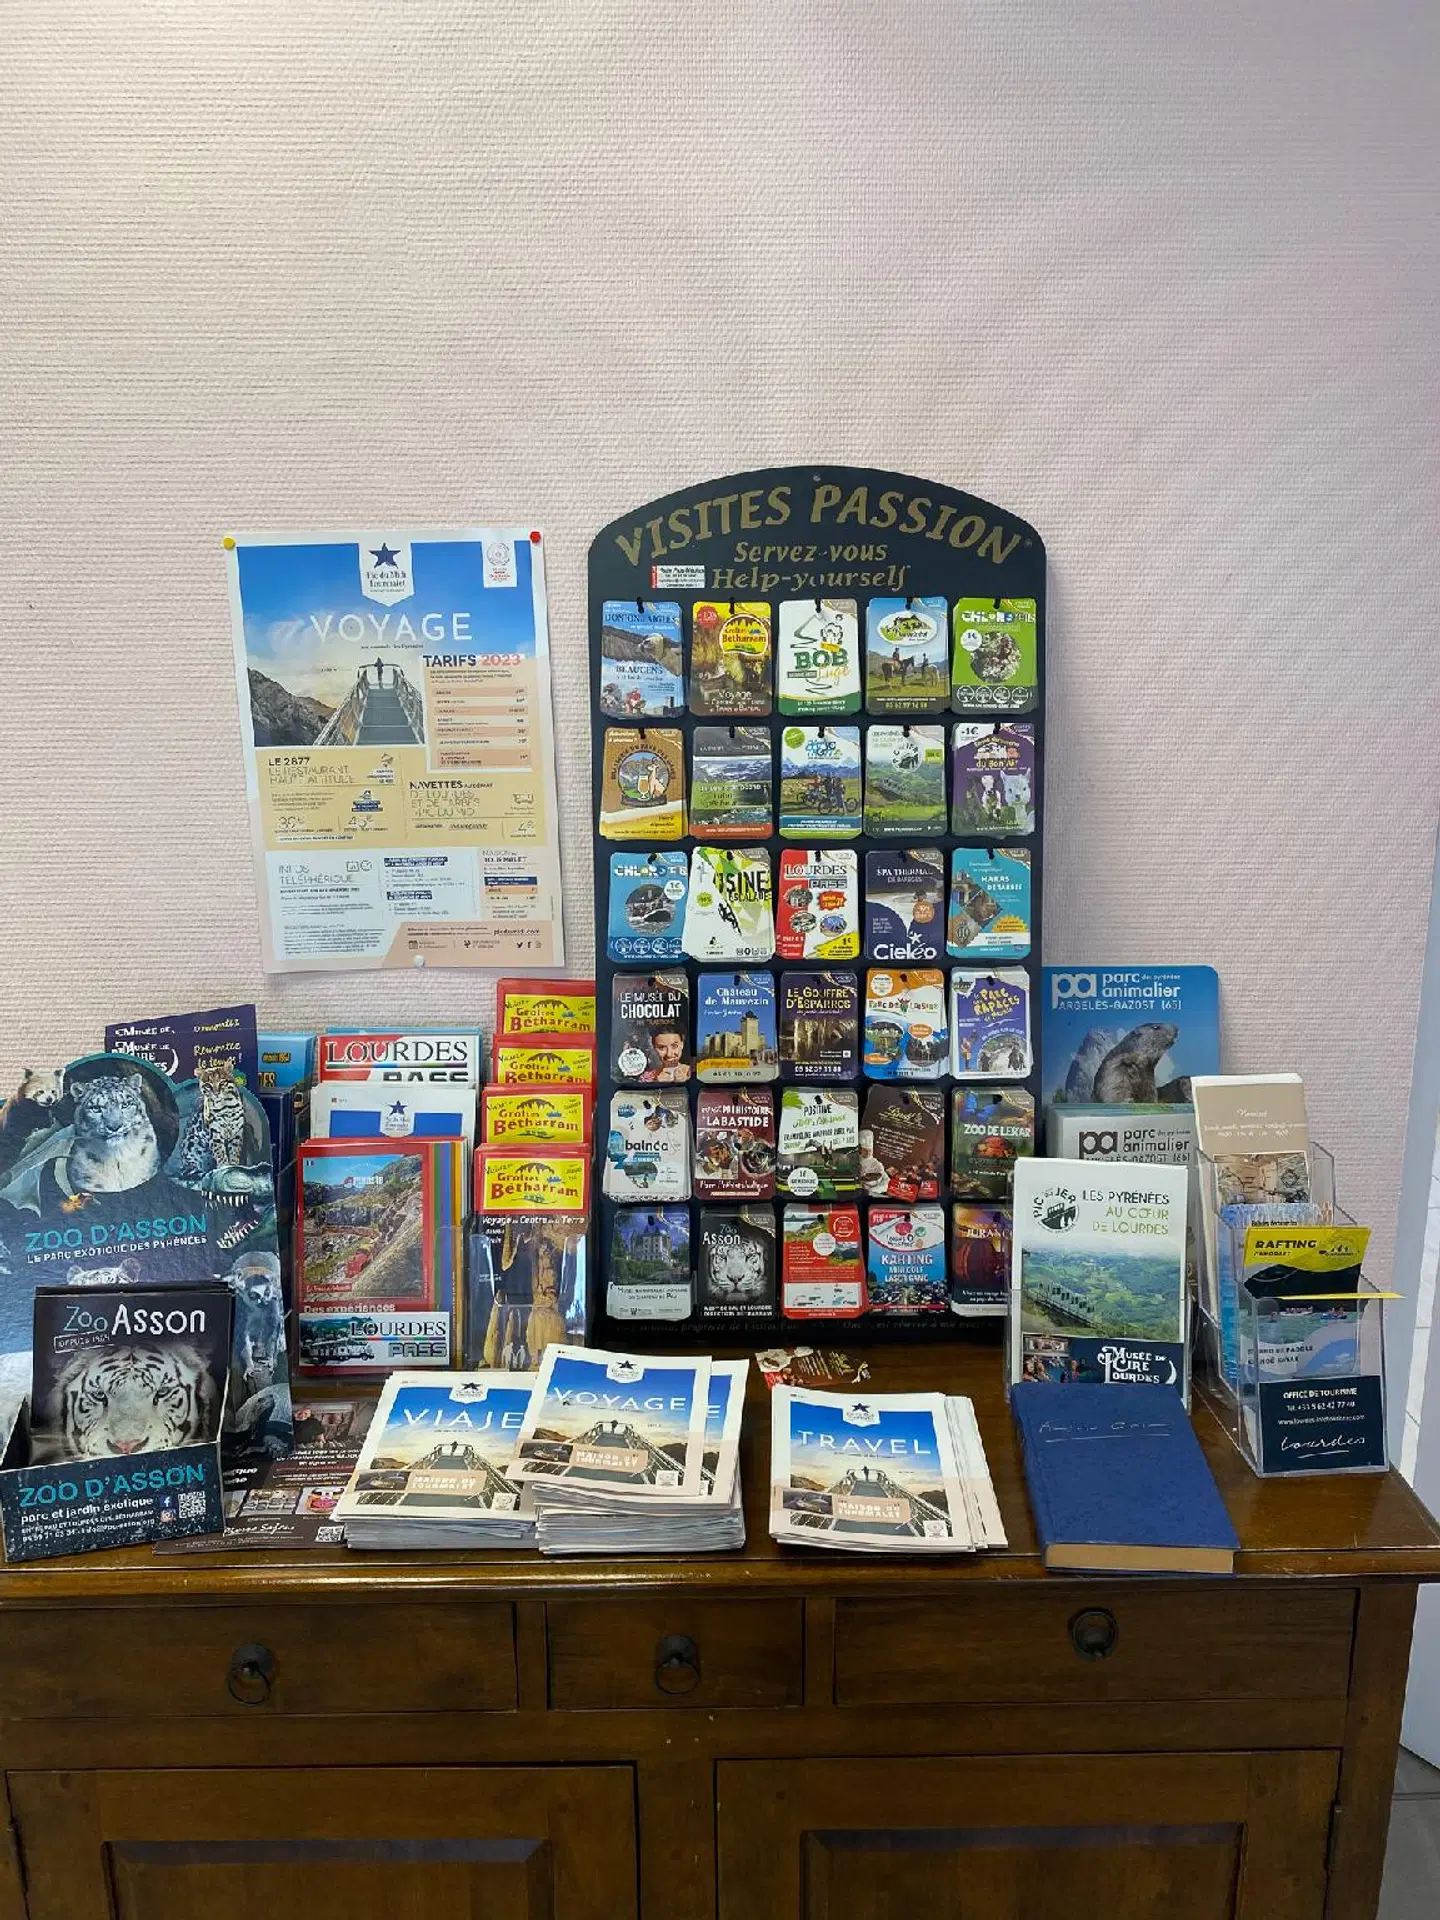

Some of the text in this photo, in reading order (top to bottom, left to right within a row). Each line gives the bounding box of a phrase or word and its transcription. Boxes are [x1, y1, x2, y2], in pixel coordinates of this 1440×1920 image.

[614, 484, 1021, 567] VISITES PASSION
[309, 612, 474, 643] VOYAGE
[422, 653, 523, 668] TARIFS 2023
[794, 647, 849, 670] BOB
[268, 757, 311, 766] LE 2877
[410, 780, 464, 789] NAVETTES
[784, 864, 848, 875] LOURDES
[809, 878, 848, 888] PASS
[874, 943, 937, 960] Cieléo
[717, 987, 757, 996] Château
[787, 989, 800, 998] LE
[1051, 973, 1098, 1009] pa
[1102, 972, 1140, 985] parc
[1102, 982, 1181, 998] animalier
[705, 996, 718, 1005] de
[621, 1003, 682, 1018] CHOCOLAT
[326, 1040, 469, 1063] LOURDES
[706, 1116, 769, 1127] LABASTIDE
[963, 1123, 985, 1135] ZOO
[987, 1125, 1000, 1135] DE
[1123, 1129, 1156, 1140] parc
[1122, 1139, 1190, 1153] animalier
[1033, 1196, 1044, 1218] PIC
[1055, 1187, 1077, 1204] JER
[1083, 1189, 1170, 1204] LES PYRÉNÉES
[1106, 1207, 1123, 1219] AU
[482, 1216, 512, 1226] Voyage
[1092, 1221, 1169, 1235] DE LOURDES
[24, 1213, 208, 1253] ZOO D'ASSON
[702, 1231, 741, 1245] Asson
[44, 1250, 72, 1262] PARC
[74, 1245, 128, 1258] EXOTIQUE
[130, 1241, 150, 1252] DES
[1255, 1239, 1318, 1250] RAFTING
[881, 1254, 933, 1265] KARTING
[63, 1303, 206, 1336] Zoo Asson
[351, 1320, 447, 1337] LOURDES
[388, 1342, 447, 1358] PASS
[1112, 1358, 1150, 1373] CIRE
[554, 1386, 687, 1413] VOYAGE
[1283, 1390, 1308, 1399] OFFICE
[1309, 1389, 1319, 1397] DE
[402, 1409, 524, 1430] VIAJE
[797, 1429, 931, 1455] TRAVEL
[19, 1463, 205, 1508] ZOO D'ASSON
[21, 1496, 154, 1525] parc et jardin exotique
